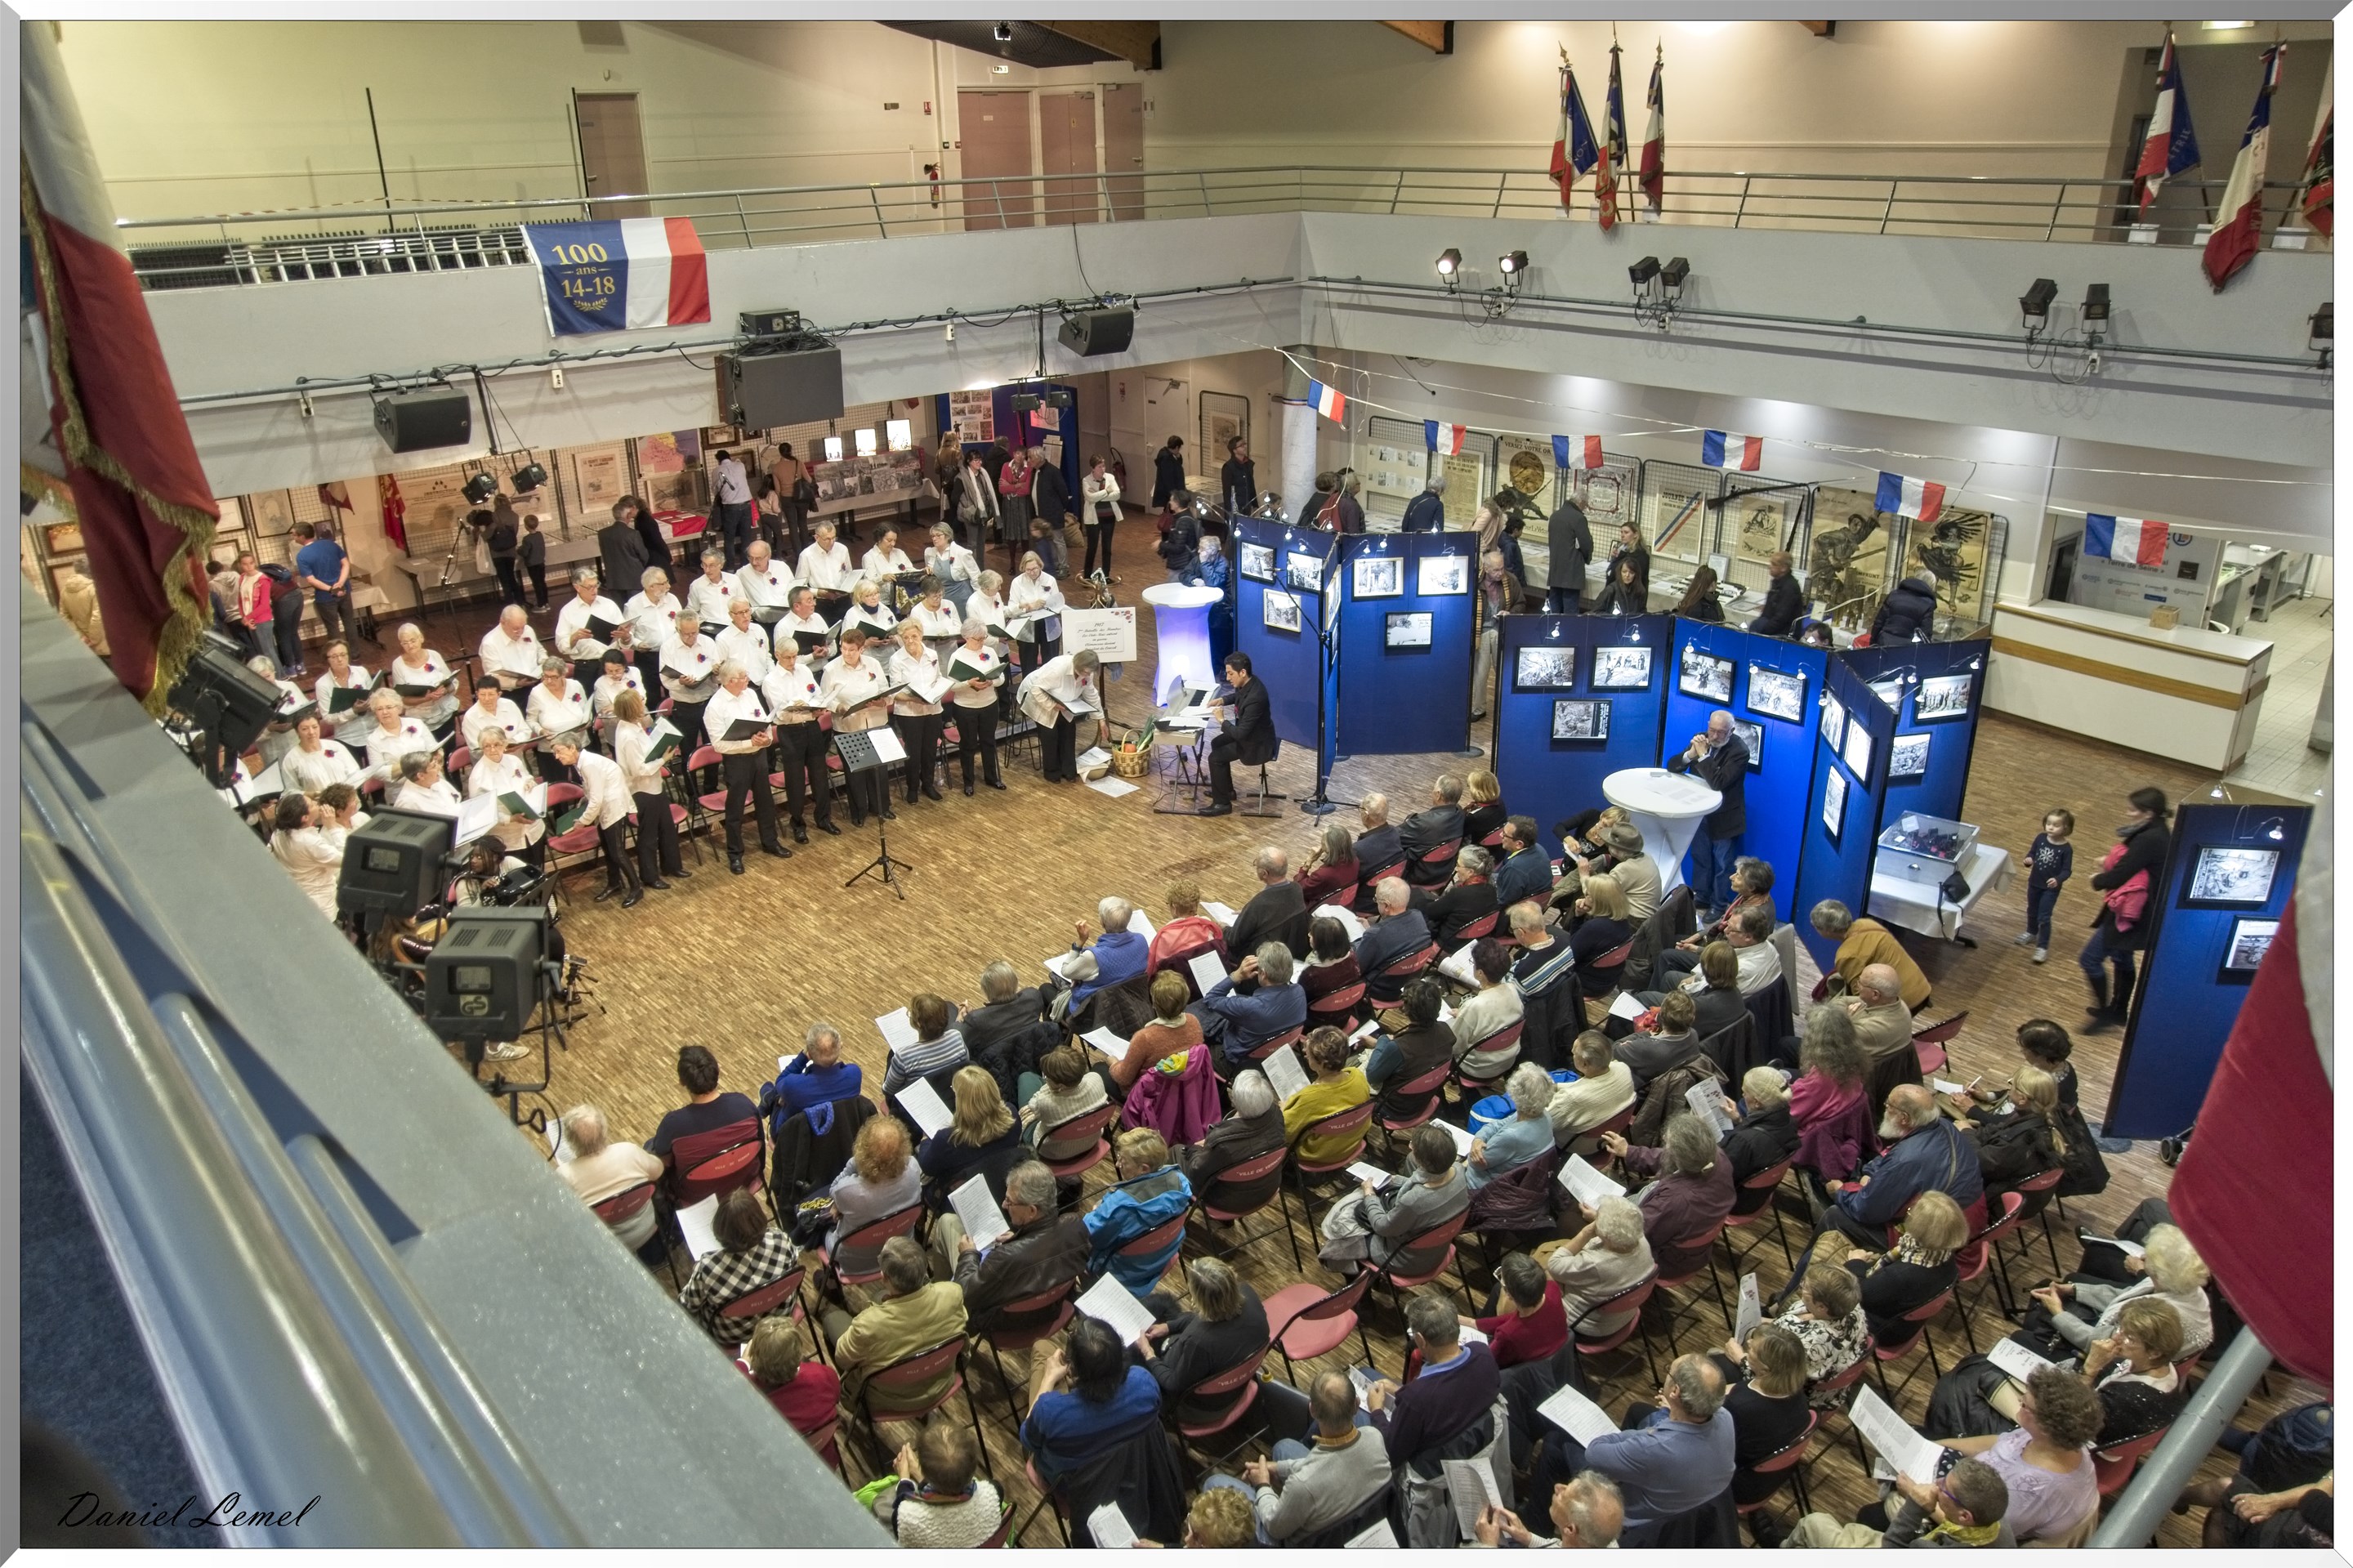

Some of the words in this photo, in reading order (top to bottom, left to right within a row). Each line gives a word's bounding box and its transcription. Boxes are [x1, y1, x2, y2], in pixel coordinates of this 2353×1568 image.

[551, 243, 608, 266] 100
[576, 266, 597, 275] ans
[561, 276, 615, 298] 14-18
[1505, 441, 1523, 449] VERSEZ
[2108, 559, 2125, 568] Terre
[2138, 564, 2159, 573] Seine
